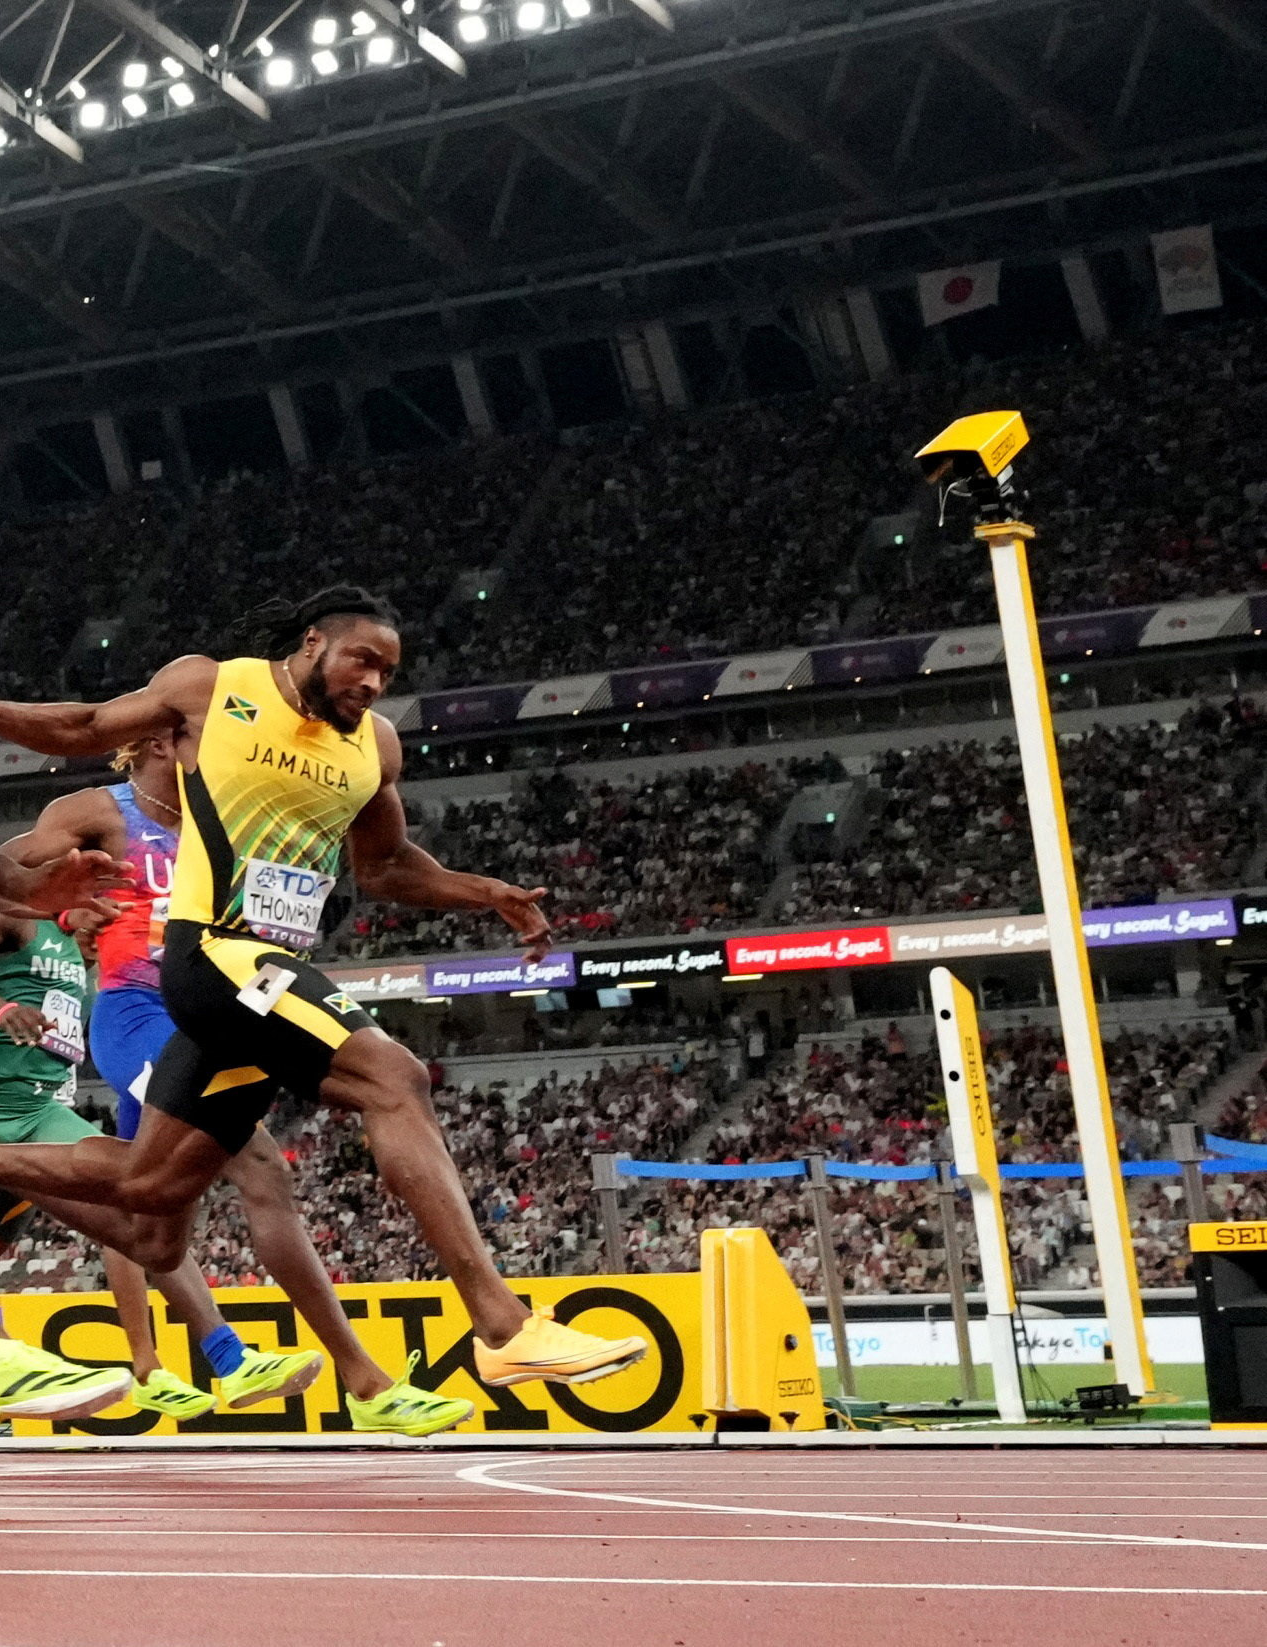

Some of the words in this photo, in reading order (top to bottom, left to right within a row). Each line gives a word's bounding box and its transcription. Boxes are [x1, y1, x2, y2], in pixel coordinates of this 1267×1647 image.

[246, 742, 350, 792] JAMAICA
[898, 935, 939, 952] Every
[736, 948, 776, 964] Every
[581, 960, 621, 977] Every
[336, 977, 376, 992] econd,
[433, 971, 471, 987] Every
[814, 1332, 880, 1357] Toyo
[778, 1378, 814, 1398] SEIKO
